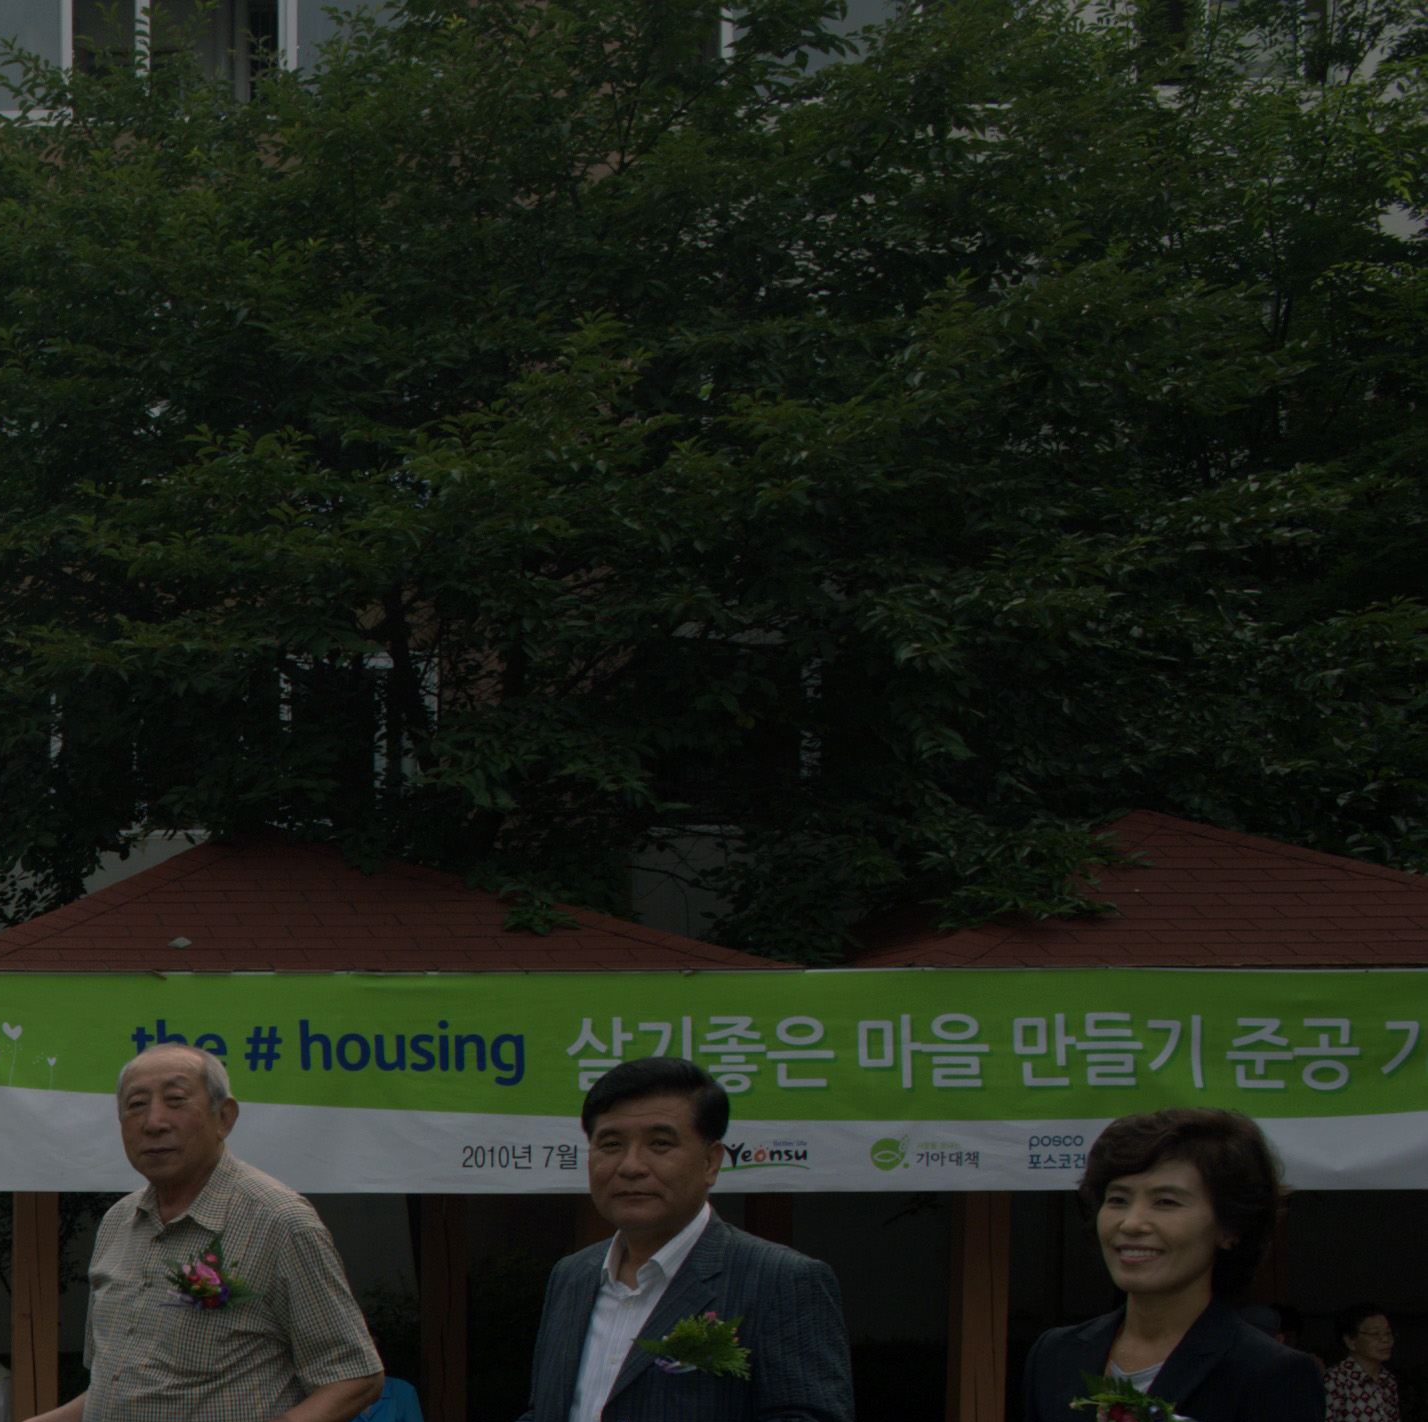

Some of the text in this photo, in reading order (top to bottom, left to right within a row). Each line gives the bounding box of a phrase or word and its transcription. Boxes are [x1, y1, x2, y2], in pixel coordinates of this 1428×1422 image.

[299, 1019, 525, 1086] housing
[566, 1015, 835, 1093] 살기좋은
[857, 1013, 991, 1088] 마을
[1012, 1012, 1204, 1089] 만들기
[1225, 1016, 1361, 1090] 준공
[723, 1142, 808, 1168] Yeonsu
[1029, 1135, 1084, 1150] posco
[462, 1145, 578, 1170] 2010년 7월
